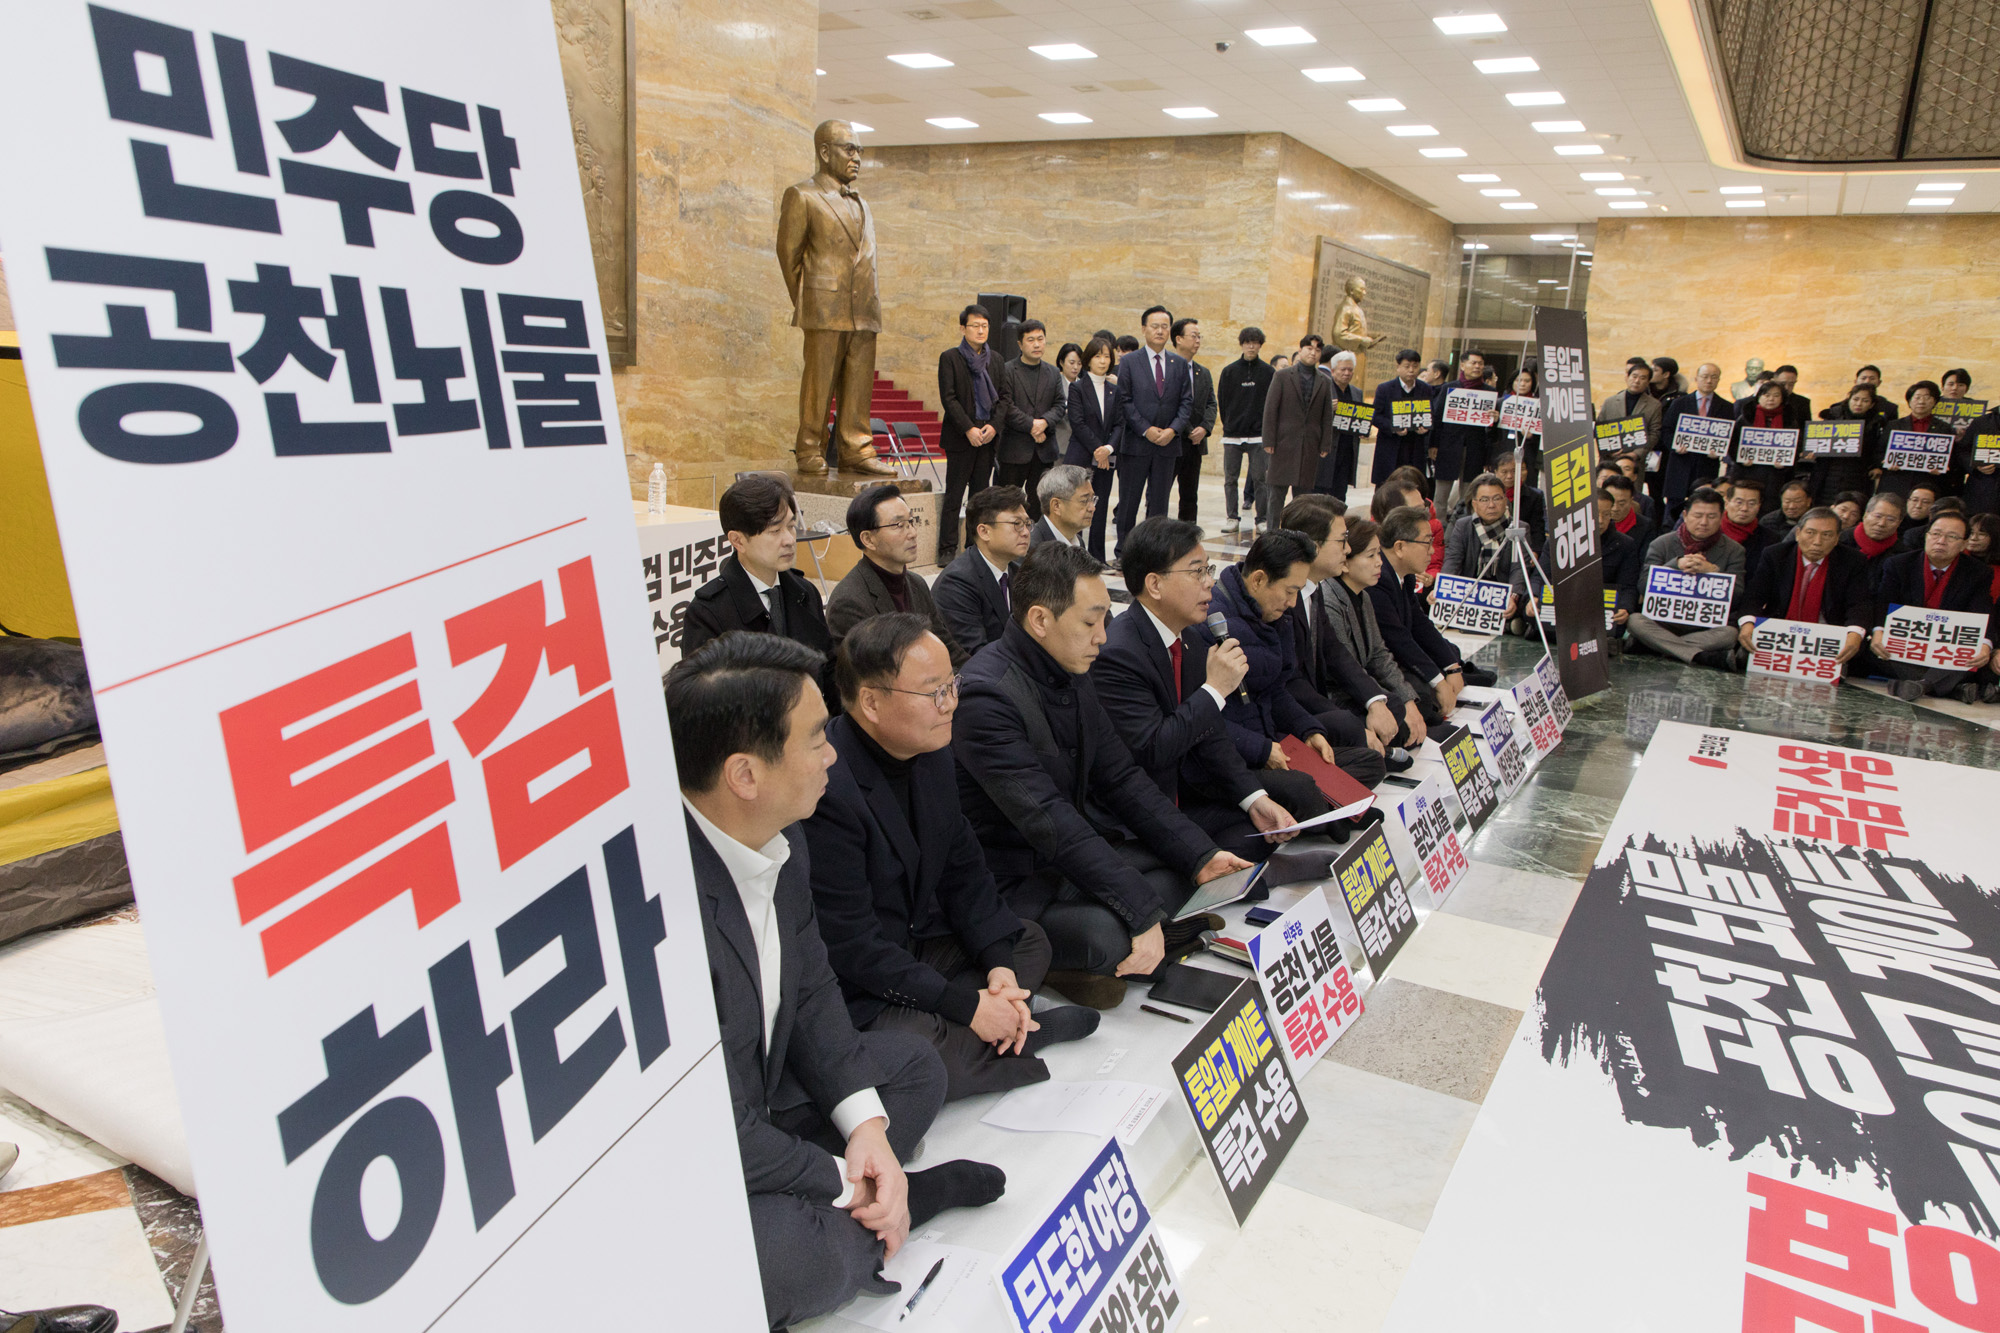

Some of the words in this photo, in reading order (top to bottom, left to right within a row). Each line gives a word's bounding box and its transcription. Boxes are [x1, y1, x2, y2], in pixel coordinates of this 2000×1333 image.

[86, 2, 525, 266] 민주당
[1543, 345, 1585, 383] 통일교
[1353, 404, 1376, 420] 게이트
[1392, 400, 1412, 414] 통일교
[1411, 399, 1432, 413] 게이트
[1446, 408, 1469, 422] 특검
[1448, 396, 1470, 409] 공천
[1471, 399, 1494, 411] 뇌물
[1503, 402, 1526, 416] 공천
[1526, 404, 1541, 419] 뇌
[1546, 386, 1587, 424] 게이트
[1931, 401, 1956, 416] 일교
[1954, 402, 1985, 418] 게이트
[1332, 414, 1352, 431] 특검
[1350, 419, 1371, 434] 수용
[1392, 414, 1412, 428] 특검
[1412, 413, 1433, 427] 수용
[1501, 414, 1524, 429] 특검
[1619, 416, 1645, 433] 게이트
[1680, 416, 1710, 434] 무도한
[1709, 420, 1730, 438] 여당
[1806, 423, 1833, 438] 통일교
[1833, 423, 1862, 438] 게이트
[1597, 435, 1623, 451] 특검
[1622, 430, 1647, 448] 수용
[1675, 433, 1692, 449] 야당
[1692, 436, 1710, 452] 탄압
[1709, 438, 1728, 455] 중단
[1742, 429, 1775, 446] 무도한
[1773, 432, 1796, 447] 여당
[1804, 438, 1832, 454] 특검
[1832, 437, 1860, 453] 수용
[1892, 433, 1927, 451] 무도한
[1926, 436, 1950, 453] 여당
[1976, 434, 2000, 448] 통일
[1739, 446, 1756, 462] 야당
[1757, 447, 1775, 462] 탄압
[1775, 448, 1794, 464] 중단
[1887, 451, 1907, 467] 야당
[1907, 452, 1927, 468] 탄압
[1927, 454, 1947, 471] 중단
[1550, 442, 1593, 510] 특검
[1553, 502, 1597, 570] 하라
[1438, 579, 1478, 604] 무도한
[1478, 585, 1508, 607] 여당
[1652, 570, 1697, 596] 무도한
[1697, 576, 1730, 600] 여당
[1433, 601, 1456, 622] 야당
[1456, 605, 1480, 627] 탄압
[1479, 609, 1504, 632] 중단
[1646, 595, 1672, 618] 야당
[1672, 599, 1699, 622] 탄압
[1699, 602, 1727, 625] 중단
[1925, 614, 1950, 624] 민주당
[1756, 630, 1796, 653] 공천
[1798, 636, 1841, 658] 뇌물
[1789, 625, 1811, 635] 민주당
[1889, 617, 1932, 641] 공천
[1935, 624, 1981, 647] 뇌물
[1753, 650, 1793, 674] 특검
[1796, 656, 1839, 679] 수용
[1885, 637, 1929, 662] 특검
[1932, 645, 1976, 667] 수용
[1520, 698, 1540, 728] 공천
[1530, 722, 1550, 752] 특검
[218, 555, 631, 979] 특검
[1778, 744, 1900, 795] 수용
[1458, 778, 1483, 817] 특검
[1474, 766, 1495, 805] 수용
[1408, 813, 1437, 862] 공천
[1426, 797, 1452, 843] 뇌물
[1773, 785, 1911, 853] 특검
[1340, 856, 1375, 916] 통일교
[1362, 835, 1395, 890] 게이트
[1423, 850, 1451, 894] 특검
[1442, 832, 1465, 876] 수용
[1357, 900, 1393, 958] 특검
[1382, 877, 1412, 933] 수용
[1625, 846, 1816, 966] 뇌물
[1282, 919, 1304, 946] 민주당
[1264, 946, 1312, 1016] 공천
[1300, 918, 1343, 985] 뇌물
[1282, 994, 1329, 1061] 특검
[1322, 965, 1359, 1028] 수용
[1651, 942, 1896, 1116] 공천
[276, 824, 668, 1306] 하라
[1183, 1036, 1241, 1131] 통일교
[1222, 997, 1274, 1085] 게이트
[1211, 1098, 1268, 1192] 특검
[1254, 1056, 1299, 1142] 수용
[1013, 1203, 1103, 1333] 무도한
[1083, 1152, 1139, 1252] 여당
[1125, 1233, 1180, 1333] 중단
